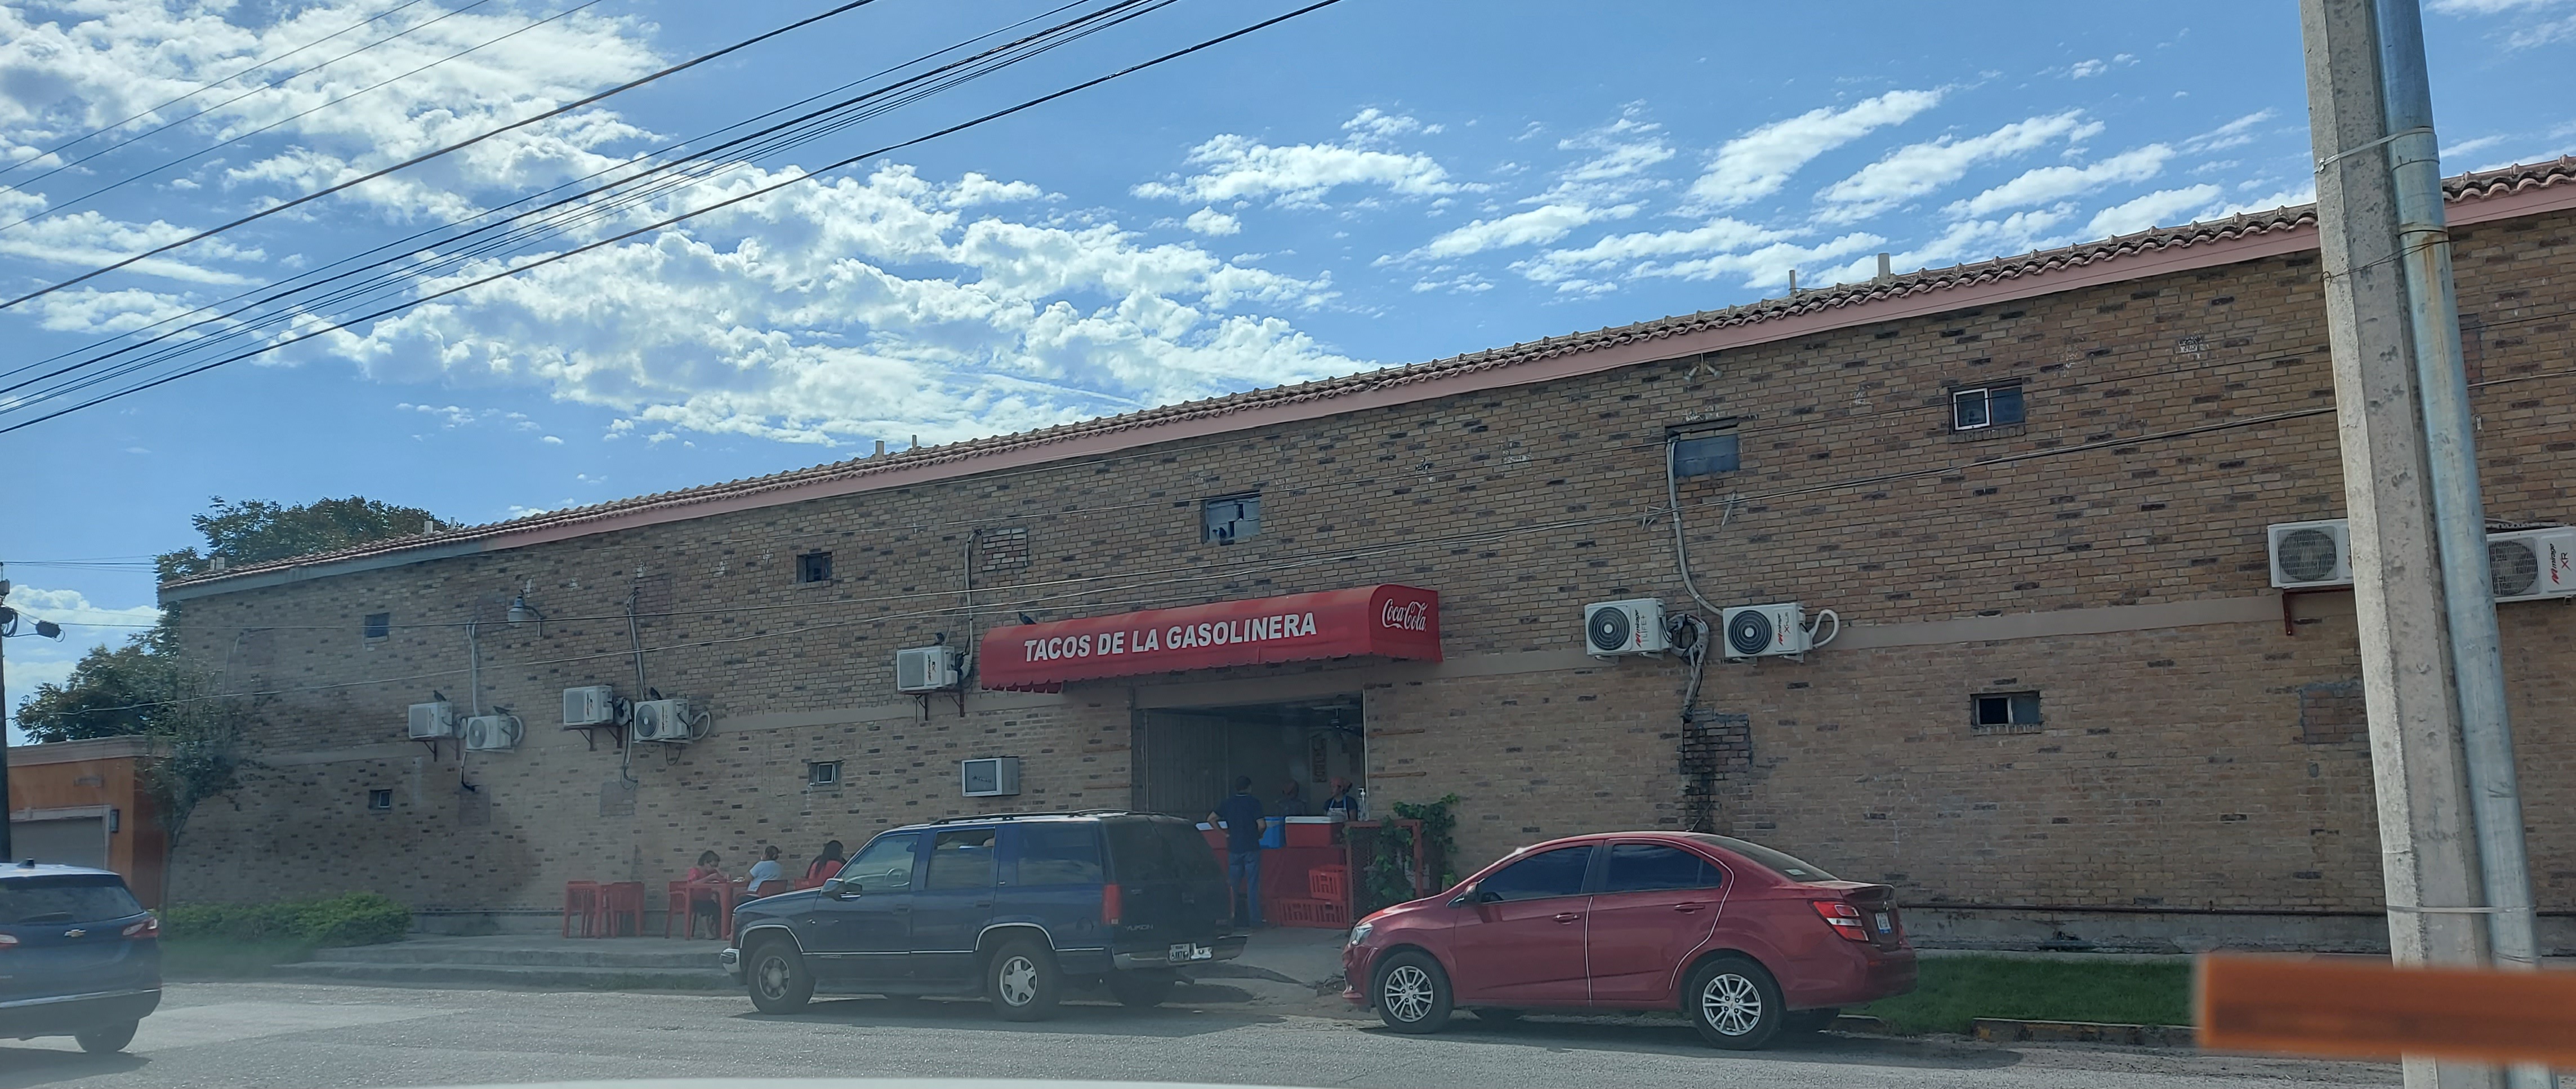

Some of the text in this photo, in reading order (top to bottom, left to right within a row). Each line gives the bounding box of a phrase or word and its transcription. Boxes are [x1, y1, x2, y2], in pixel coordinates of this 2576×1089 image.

[1024, 612, 1317, 662] TACOS DE LA GASOLINERA
